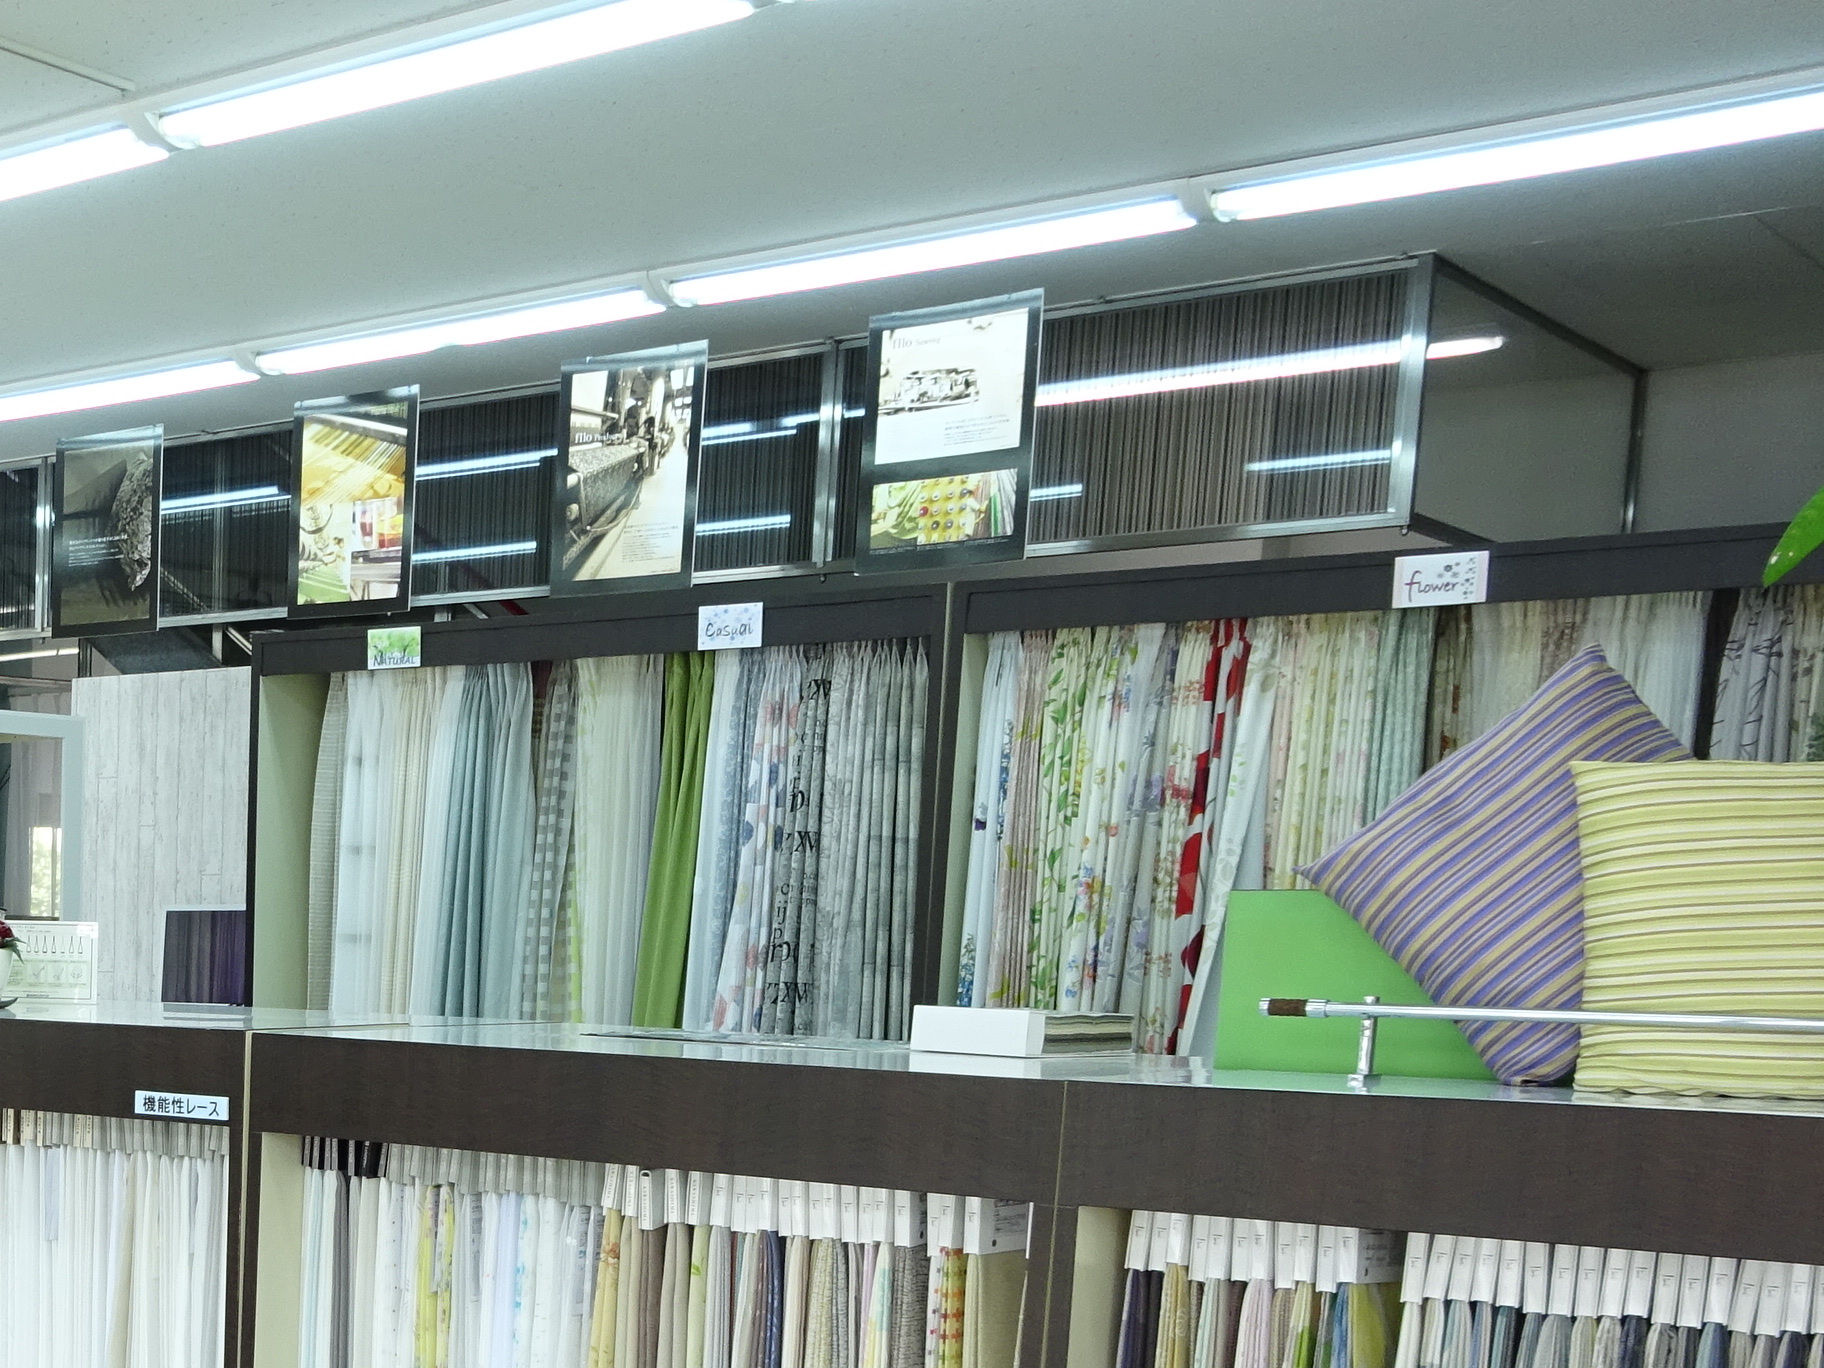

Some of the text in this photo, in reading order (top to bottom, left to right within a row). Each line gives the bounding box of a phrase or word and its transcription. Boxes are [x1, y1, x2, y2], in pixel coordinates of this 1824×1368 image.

[1404, 570, 1459, 603] flower
[705, 622, 754, 638] Casual
[142, 1094, 220, 1117] 機能性レース
